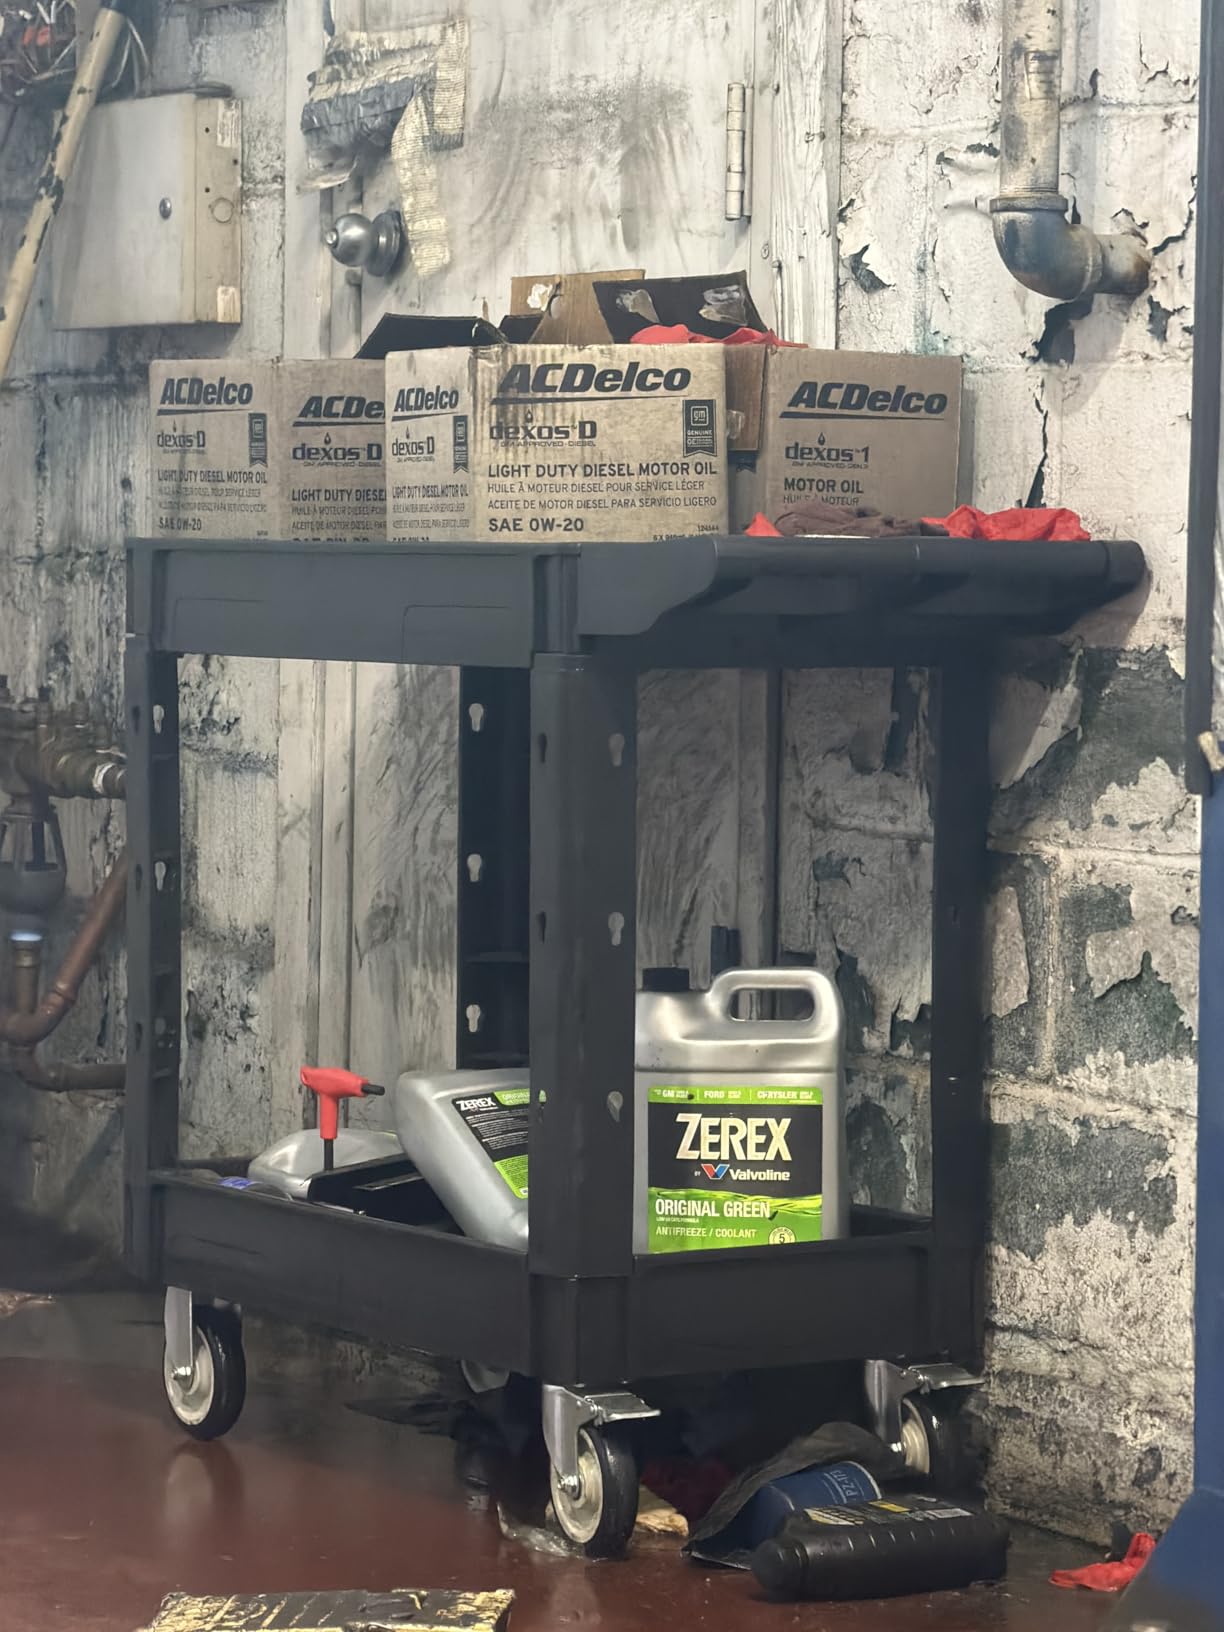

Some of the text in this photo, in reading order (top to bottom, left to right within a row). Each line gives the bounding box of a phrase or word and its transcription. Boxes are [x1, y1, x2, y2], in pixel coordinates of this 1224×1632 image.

[497, 361, 691, 393] ACDelco
[160, 376, 253, 405] ACDelco
[788, 381, 948, 414] ACDelco
[394, 385, 459, 412] ACDelco
[298, 396, 385, 418] ACDe
[157, 469, 267, 484] LIGHT DUTY DIESEL MOTOR OIL
[488, 462, 717, 478] LIGHT DUTY DIESEL MOTOR OIL
[422, 485, 440, 498] DIESEL
[487, 483, 516, 493] HUILE
[527, 483, 569, 493] MOTEUR
[571, 483, 604, 493] DIESEL
[606, 482, 633, 492] POUR
[634, 481, 674, 492] SERVICE
[676, 478, 705, 491] LÉGER
[784, 478, 864, 494] MOTOR OIL
[291, 488, 322, 501] LIGHT
[324, 488, 353, 501] DUTY
[488, 496, 717, 510] ACEITE DE MOTOR DIESEL PARA SERVICIO LIGERO
[159, 517, 202, 531] SAE 0W-20
[488, 518, 584, 532] SAE 0W-20
[757, 1091, 797, 1099] CHRYSLER
[456, 1097, 496, 1111] ZEREX
[675, 1113, 792, 1161] ZEREX
[729, 1168, 790, 1181] Valvoline
[655, 1198, 770, 1218] ORIGINAL GREEN
[655, 1226, 707, 1237] ANTIFREEZE
[715, 1228, 757, 1238] COOLANT
